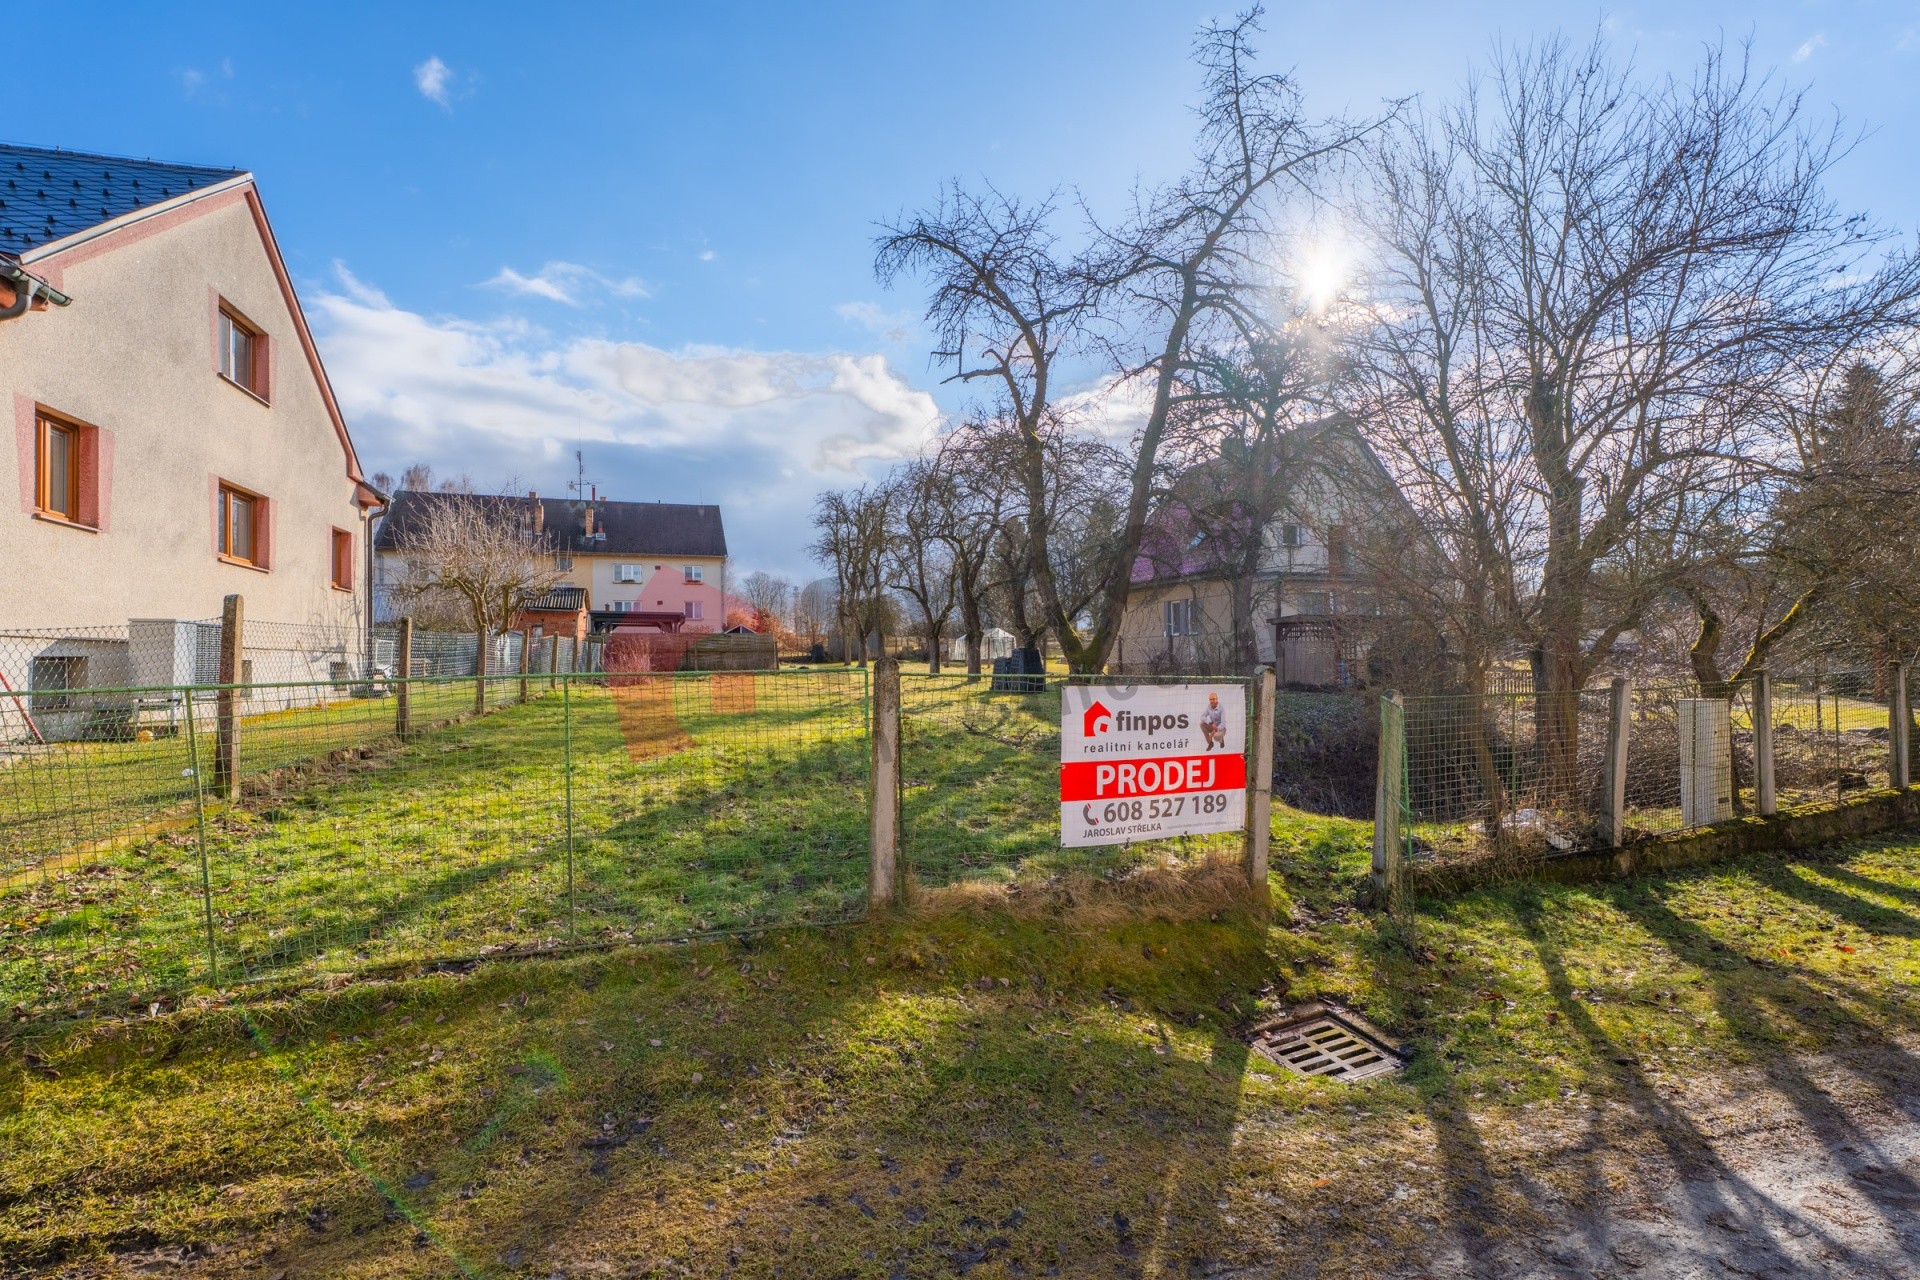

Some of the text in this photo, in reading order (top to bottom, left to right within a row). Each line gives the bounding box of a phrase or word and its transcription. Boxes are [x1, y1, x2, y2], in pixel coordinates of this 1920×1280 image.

[1116, 710, 1189, 735] finpos
[1084, 738, 1189, 753] realitní kancelář
[1096, 758, 1216, 796] PRODEJ
[1103, 793, 1227, 823] 608 527 189
[1082, 826, 1126, 839] JAROSLAV
[1127, 822, 1162, 834] STŘELKA
